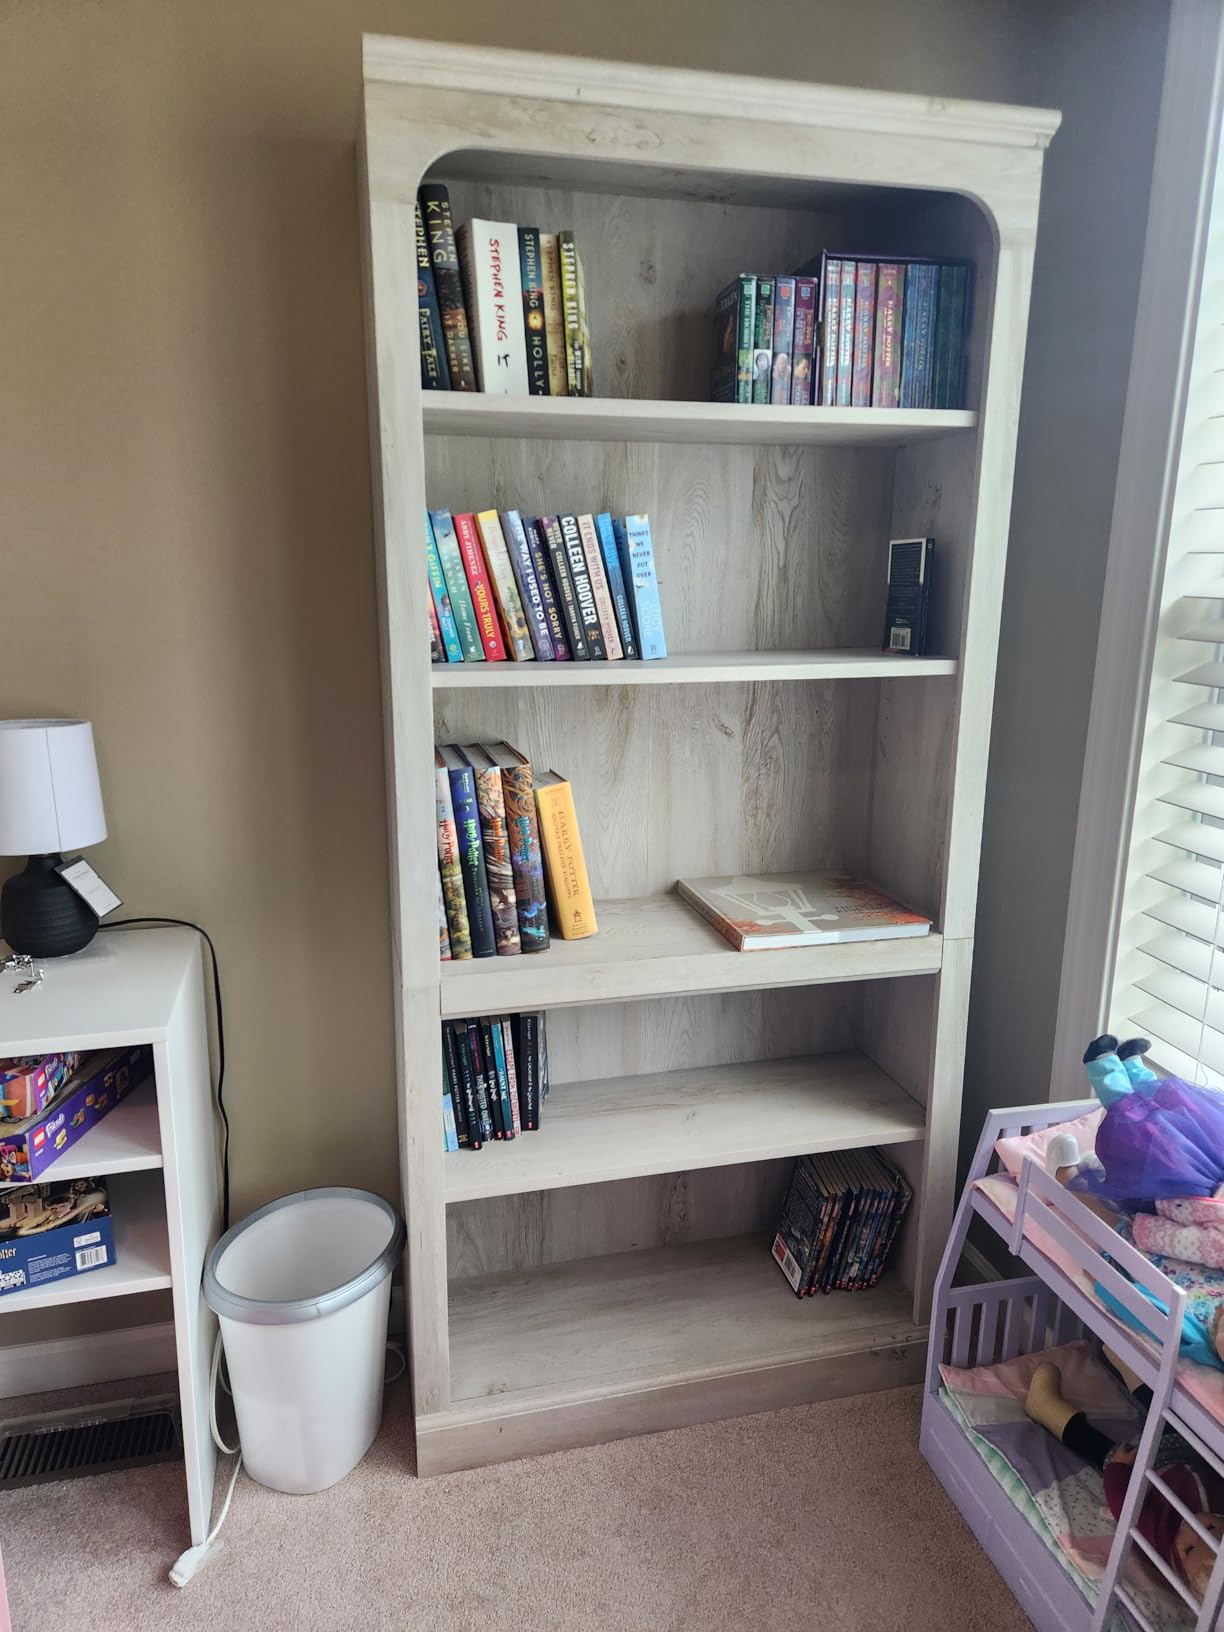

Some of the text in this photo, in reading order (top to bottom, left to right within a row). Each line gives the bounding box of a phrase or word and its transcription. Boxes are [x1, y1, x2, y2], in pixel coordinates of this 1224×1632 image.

[427, 201, 447, 263] KING
[441, 202, 457, 262] STEPHEN
[489, 238, 508, 341] STEPHEN KING
[524, 234, 539, 308] STEPHEN KING
[562, 242, 578, 330] STEPHEN KING
[419, 308, 437, 377] FAIRY TALE
[456, 315, 471, 372] YOU LIKE
[531, 336, 545, 391] HOLLY
[546, 527, 557, 549] NEVER
[552, 521, 562, 544] NEVER
[582, 522, 589, 530] IT
[584, 531, 596, 555] ENDS
[629, 529, 649, 537] THINGS
[460, 519, 470, 540] ABBY
[465, 540, 478, 576] JIMENEZ
[519, 543, 532, 567] WAY
[590, 555, 601, 578] WITH
[427, 553, 440, 588] GIFFIN
[527, 575, 541, 605] USED
[555, 551, 567, 578] COLLEEN
[561, 578, 572, 601] HOOVER
[561, 516, 597, 625] COLLEEN HOOVER
[595, 578, 604, 590] US
[475, 584, 495, 639] YOURS TRULY
[534, 551, 562, 639] SHE'S NOT SORRY
[534, 606, 545, 620] TO
[599, 597, 609, 621] COLLEEN
[464, 622, 474, 642] Front
[538, 622, 548, 636] BE
[617, 595, 631, 642] COLLEEN HOOVER
[439, 819, 452, 842] Harry
[463, 819, 480, 867] Harry Potter
[558, 810, 580, 897] HARRY POTTER
[478, 1086, 488, 1109] TWISTED
